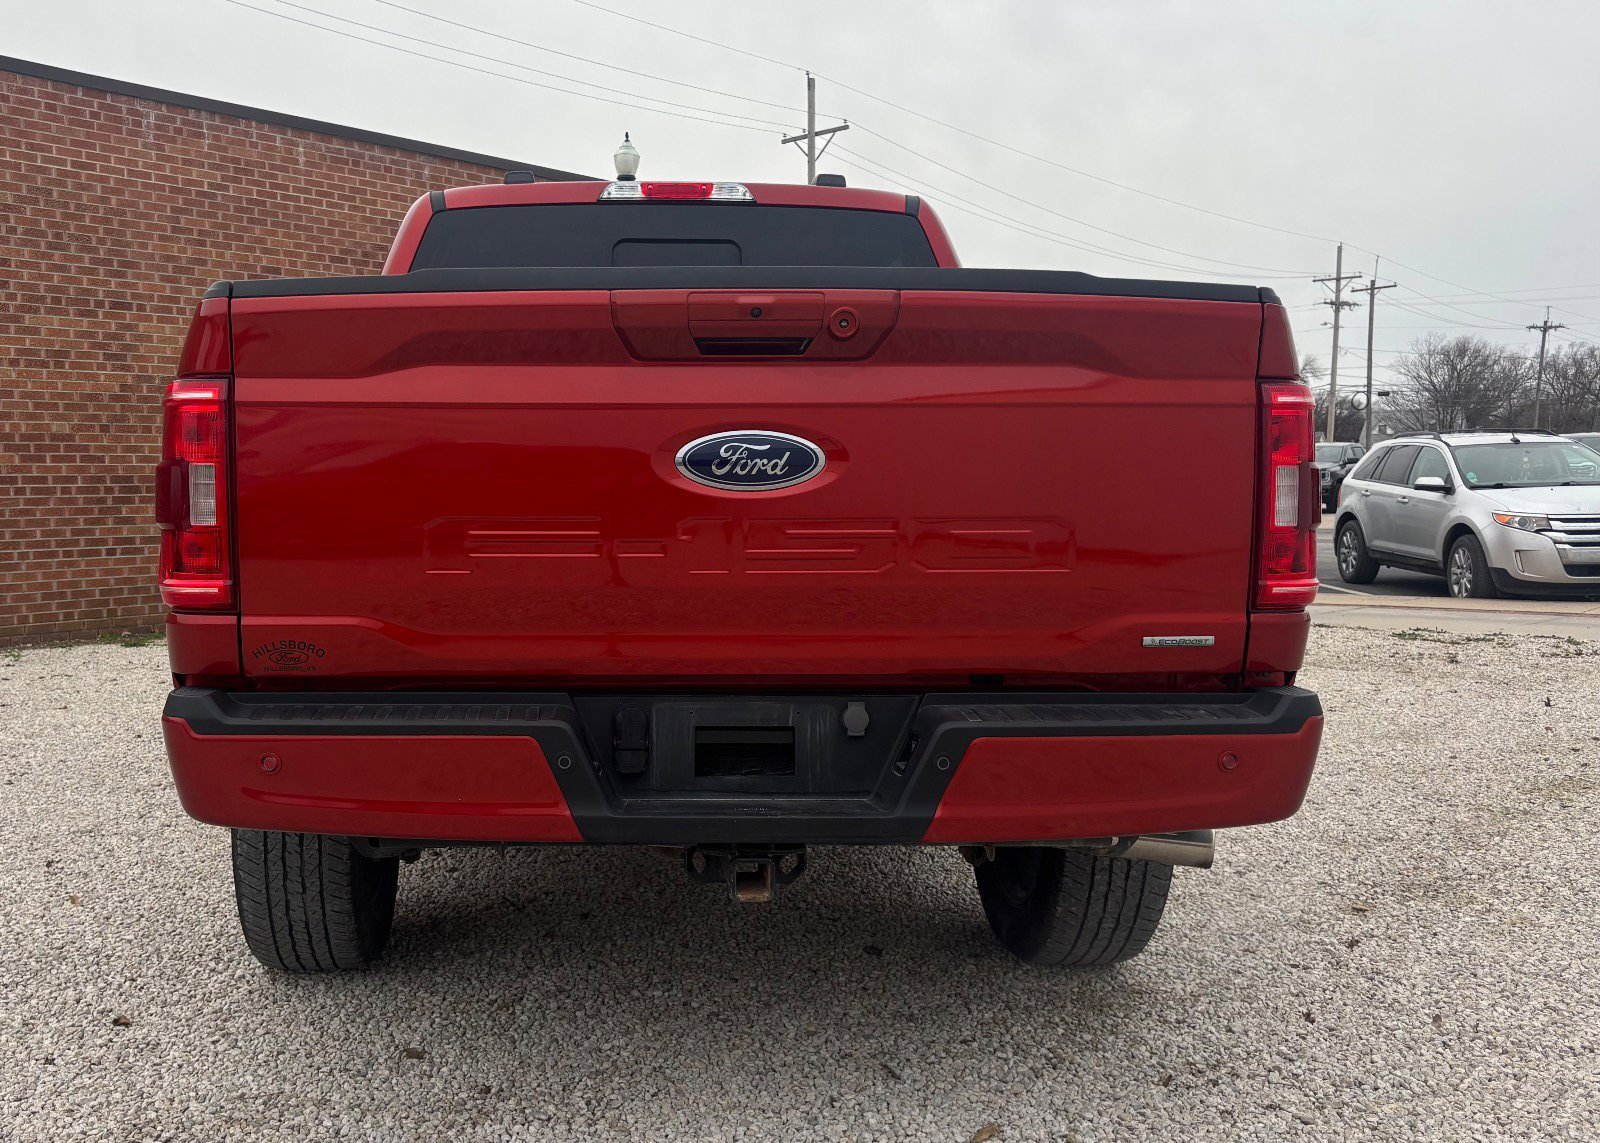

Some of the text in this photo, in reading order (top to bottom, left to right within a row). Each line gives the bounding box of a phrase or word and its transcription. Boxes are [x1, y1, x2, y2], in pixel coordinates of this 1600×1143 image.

[711, 442, 791, 476] Ford
[423, 517, 1076, 573] F-150
[252, 640, 325, 658] HILLSBORO
[275, 651, 302, 664] Ford
